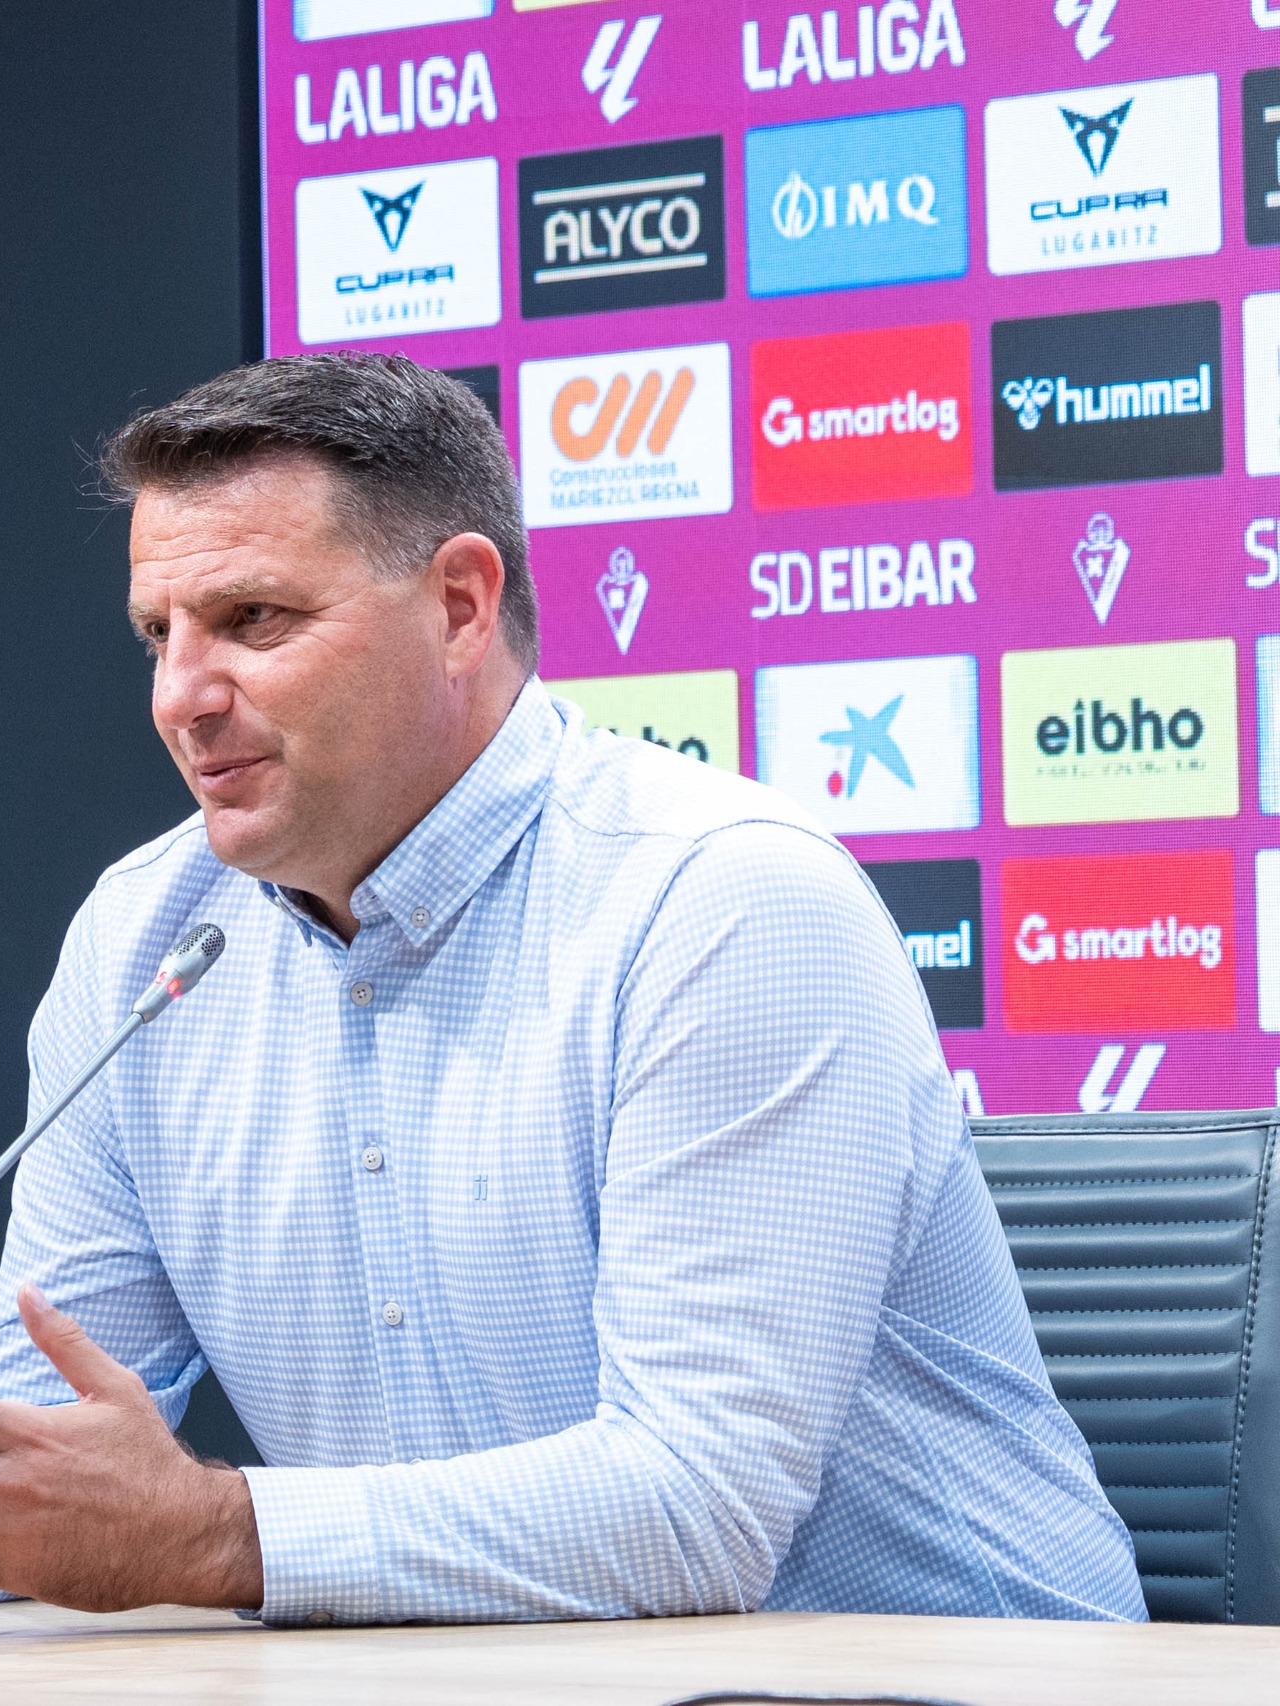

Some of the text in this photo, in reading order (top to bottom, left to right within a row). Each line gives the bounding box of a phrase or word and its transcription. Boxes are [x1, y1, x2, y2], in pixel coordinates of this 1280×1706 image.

[742, 0, 965, 91] LALIGA
[294, 50, 497, 144] LALIGA
[823, 174, 939, 227] IMQ
[1030, 188, 1167, 222] CUPRA
[543, 196, 701, 264] ALYCO
[1041, 223, 1157, 256] LUGARITZ
[336, 264, 454, 294] CUPRA
[808, 390, 960, 441] smartlog
[1056, 363, 1211, 425] hummel
[1037, 698, 1203, 756] eibho
[1063, 914, 1223, 969] smartlog
